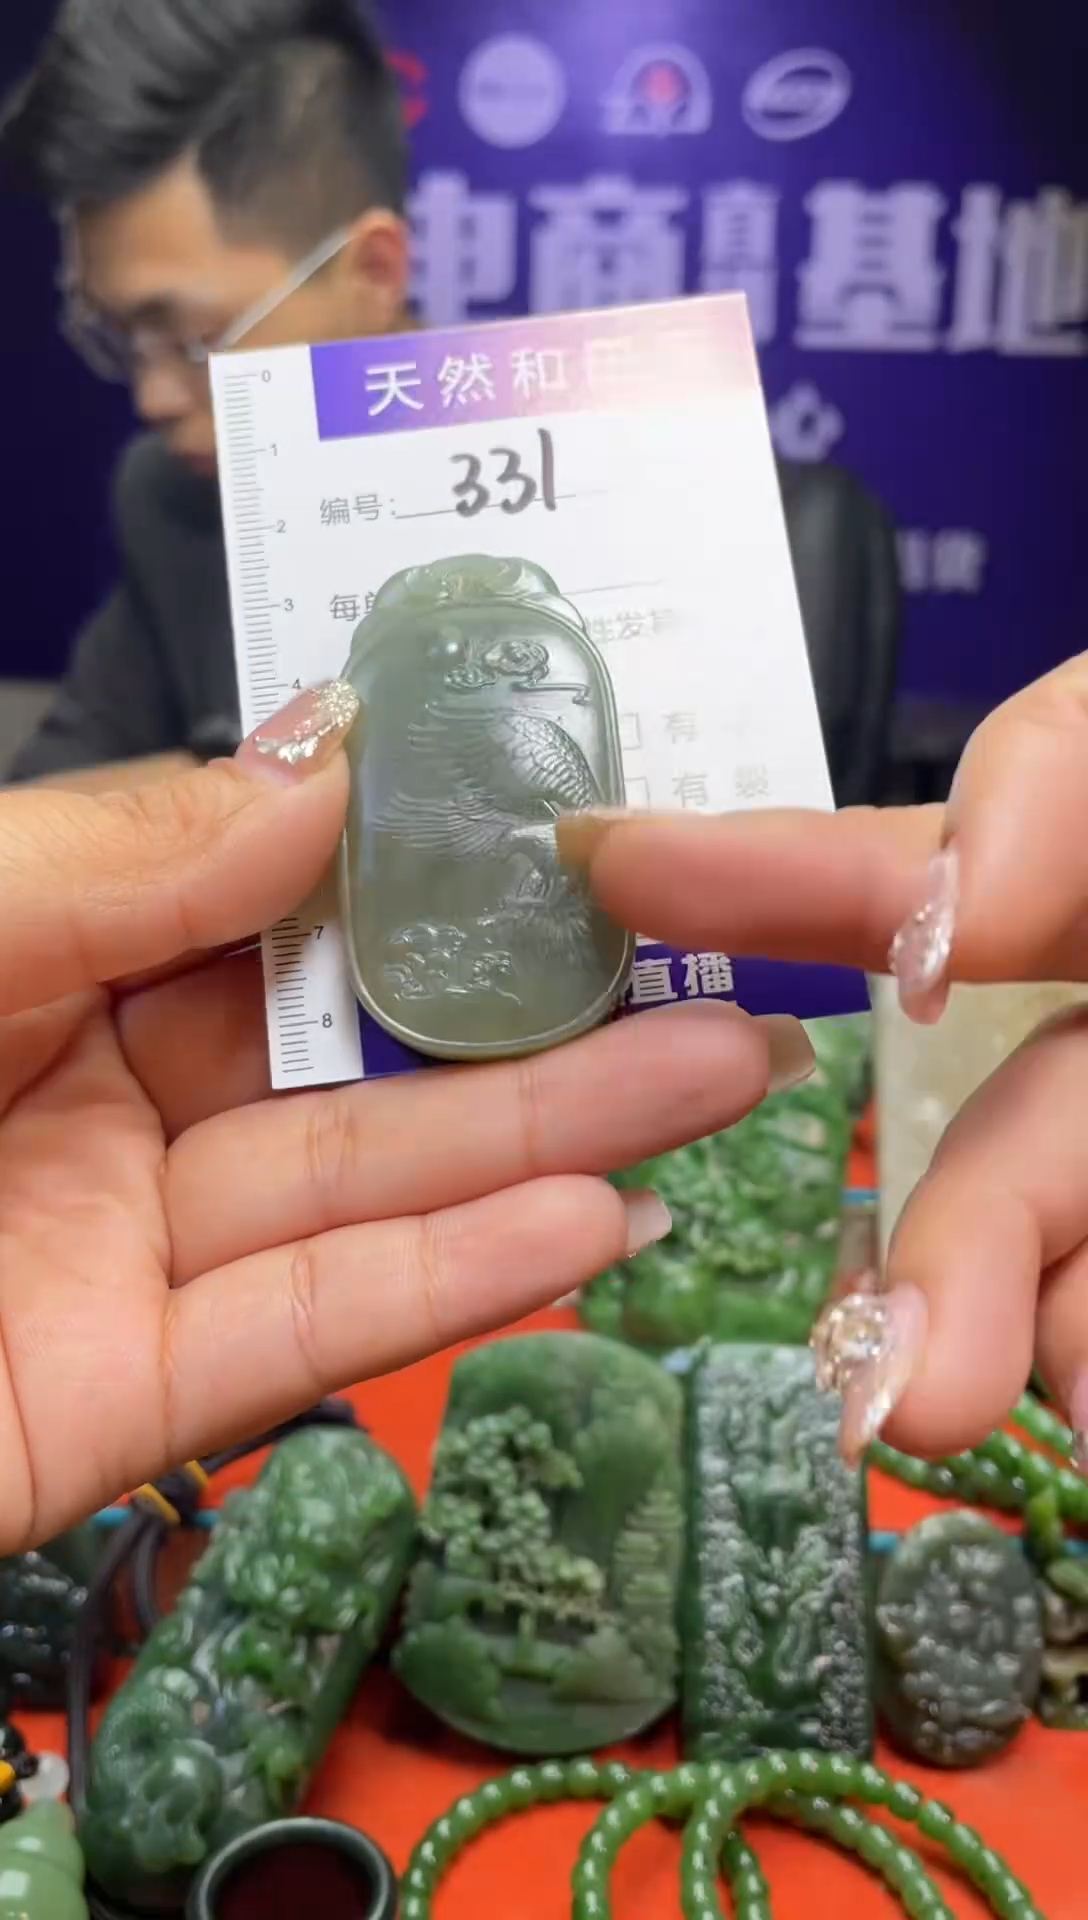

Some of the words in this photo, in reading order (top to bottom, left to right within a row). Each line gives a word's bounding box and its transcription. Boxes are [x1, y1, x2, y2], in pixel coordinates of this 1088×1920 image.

[261, 369, 271, 383] 0
[270, 443, 278, 457] 1
[448, 427, 557, 518] 331
[276, 519, 287, 533] 2
[284, 598, 294, 612] 3
[291, 677, 302, 690] 4
[313, 925, 325, 940] 7
[630, 952, 734, 1005] 直播
[322, 1013, 333, 1028] 8
